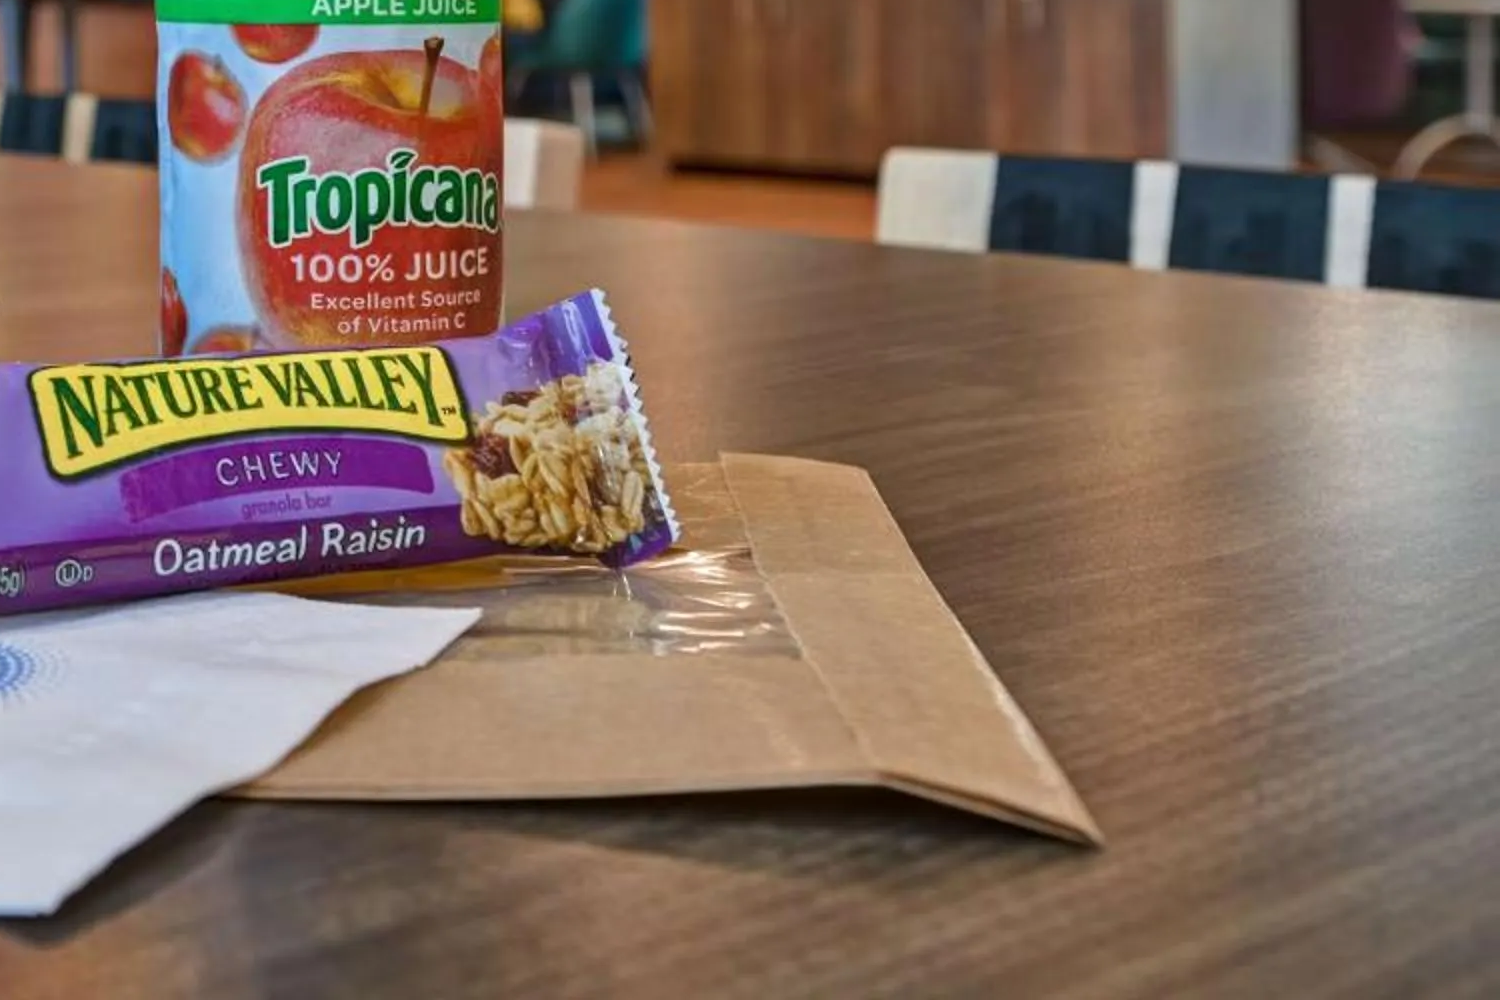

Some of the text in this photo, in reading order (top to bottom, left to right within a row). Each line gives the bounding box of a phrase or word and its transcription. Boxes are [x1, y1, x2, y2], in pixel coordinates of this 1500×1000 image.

[259, 149, 499, 247] Tropicana
[290, 248, 489, 283] 100% JUICE
[311, 288, 481, 310] Excellent Source
[337, 311, 466, 334] of Vitamin C
[51, 362, 262, 459] NATURE
[256, 351, 443, 427] VALLEY
[215, 451, 342, 486] CHEWY
[241, 491, 332, 521] granola bar
[153, 524, 308, 577] Oatmeal
[321, 515, 426, 557] Raisin
